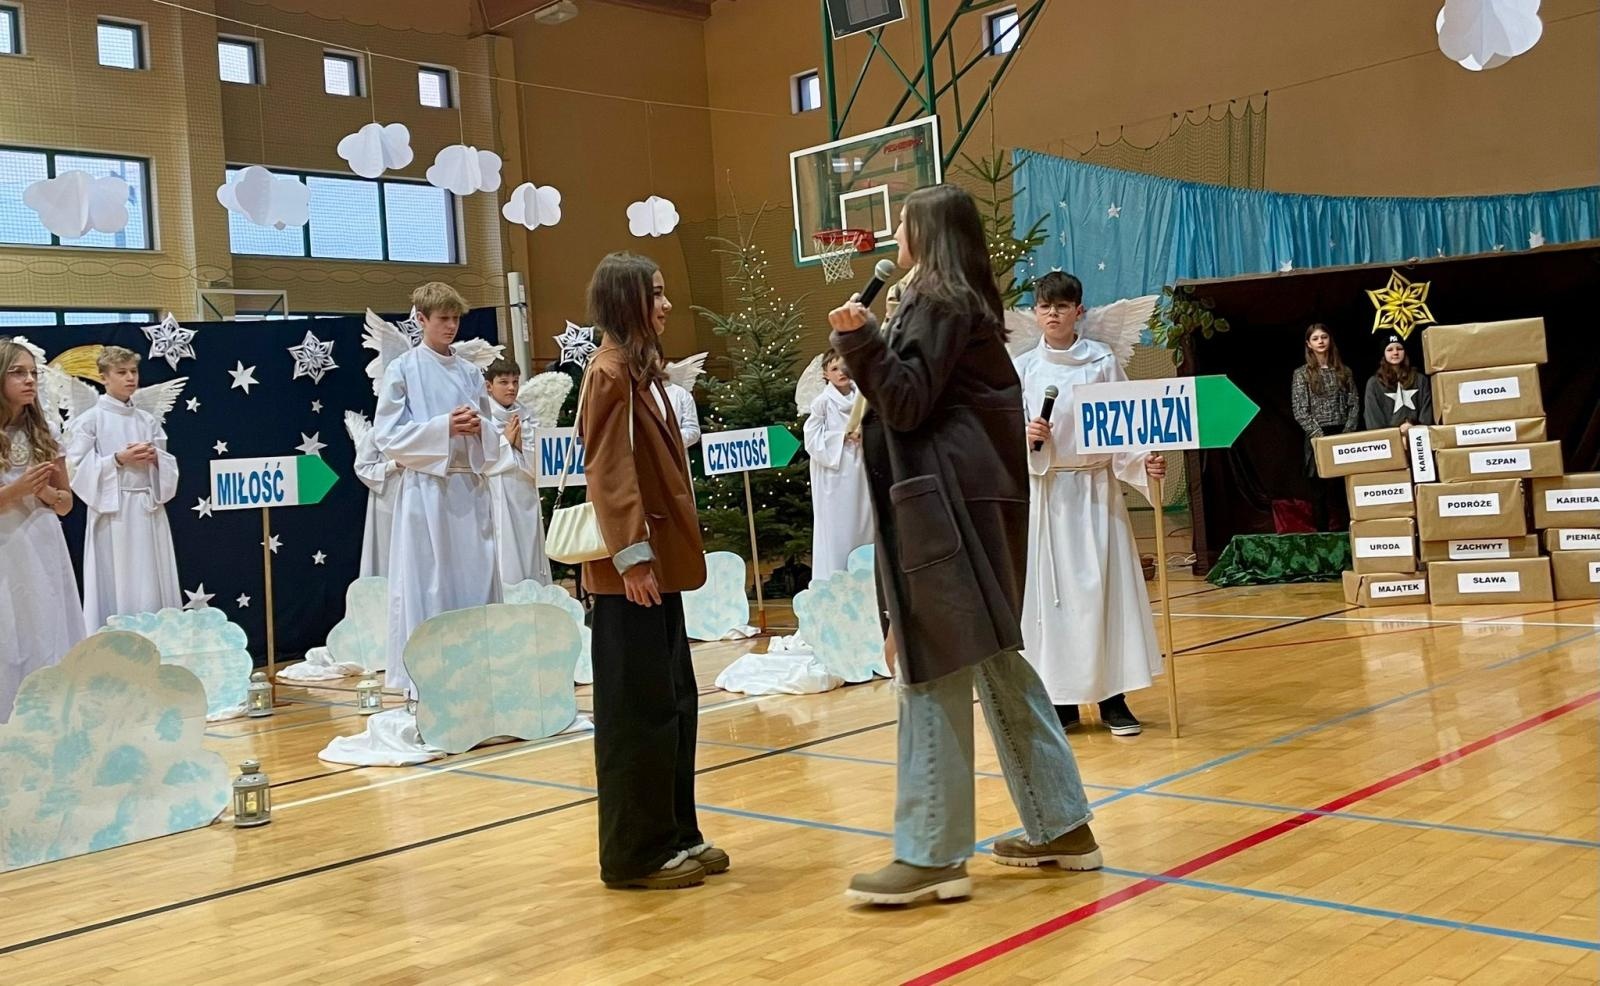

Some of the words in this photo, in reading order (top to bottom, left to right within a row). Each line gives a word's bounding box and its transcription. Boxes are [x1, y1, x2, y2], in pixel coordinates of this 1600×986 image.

[1474, 386, 1507, 396] URODA
[1082, 385, 1192, 447] PRZYJAŹŃ
[1462, 426, 1512, 436] BOGACTWO
[708, 432, 767, 471] CZYSTOŚĆ
[1338, 443, 1387, 455] BOGACTWO
[1416, 435, 1426, 472] KARIERA
[1486, 457, 1517, 466] SZPAN
[217, 462, 284, 506] MIŁOŚĆ
[1363, 488, 1405, 497] PODRÓŻE
[1447, 500, 1493, 509] PODRÓŻE
[1556, 496, 1600, 504] KARIERA
[1369, 543, 1401, 551] URODA
[1472, 576, 1507, 584] SŁAWA
[1378, 583, 1420, 594] MAJĄTEK
